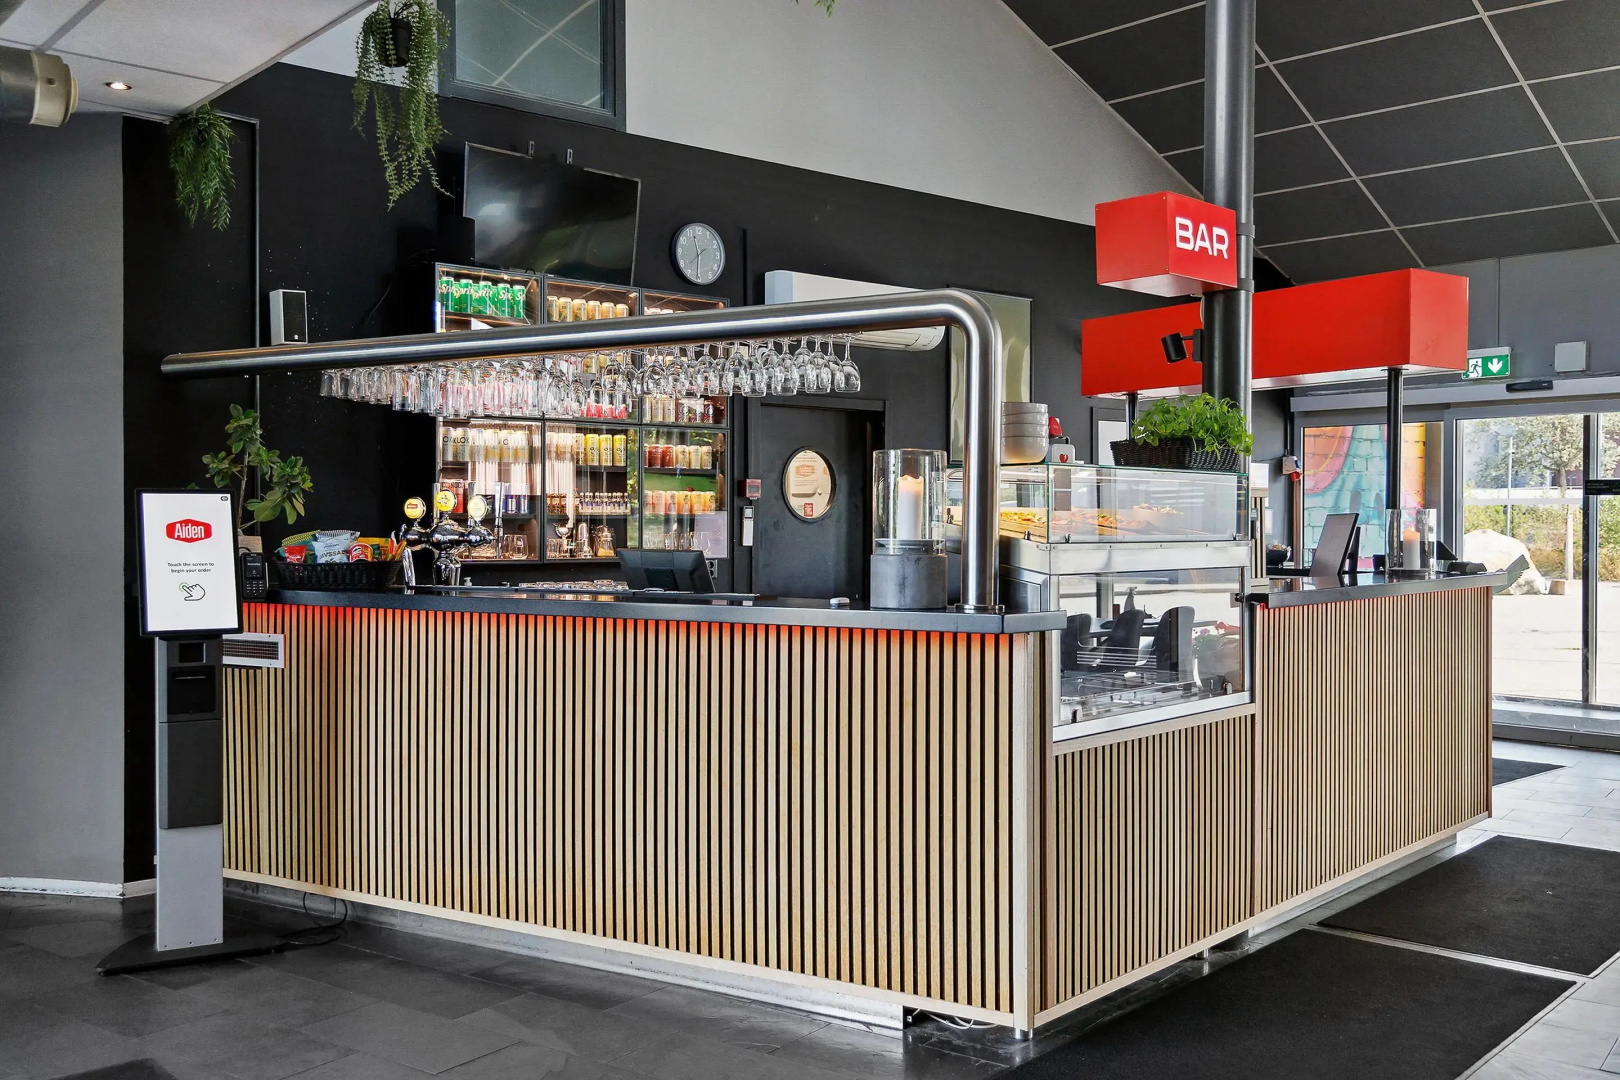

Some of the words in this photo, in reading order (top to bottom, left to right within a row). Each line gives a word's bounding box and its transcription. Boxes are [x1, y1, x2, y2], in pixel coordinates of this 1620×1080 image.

[687, 229, 693, 237] 11
[696, 226, 702, 234] 12
[706, 231, 710, 239] 1
[1175, 216, 1229, 260] BAR
[680, 236, 687, 244] 10
[712, 240, 717, 248] 2
[174, 523, 205, 539] Aiden
